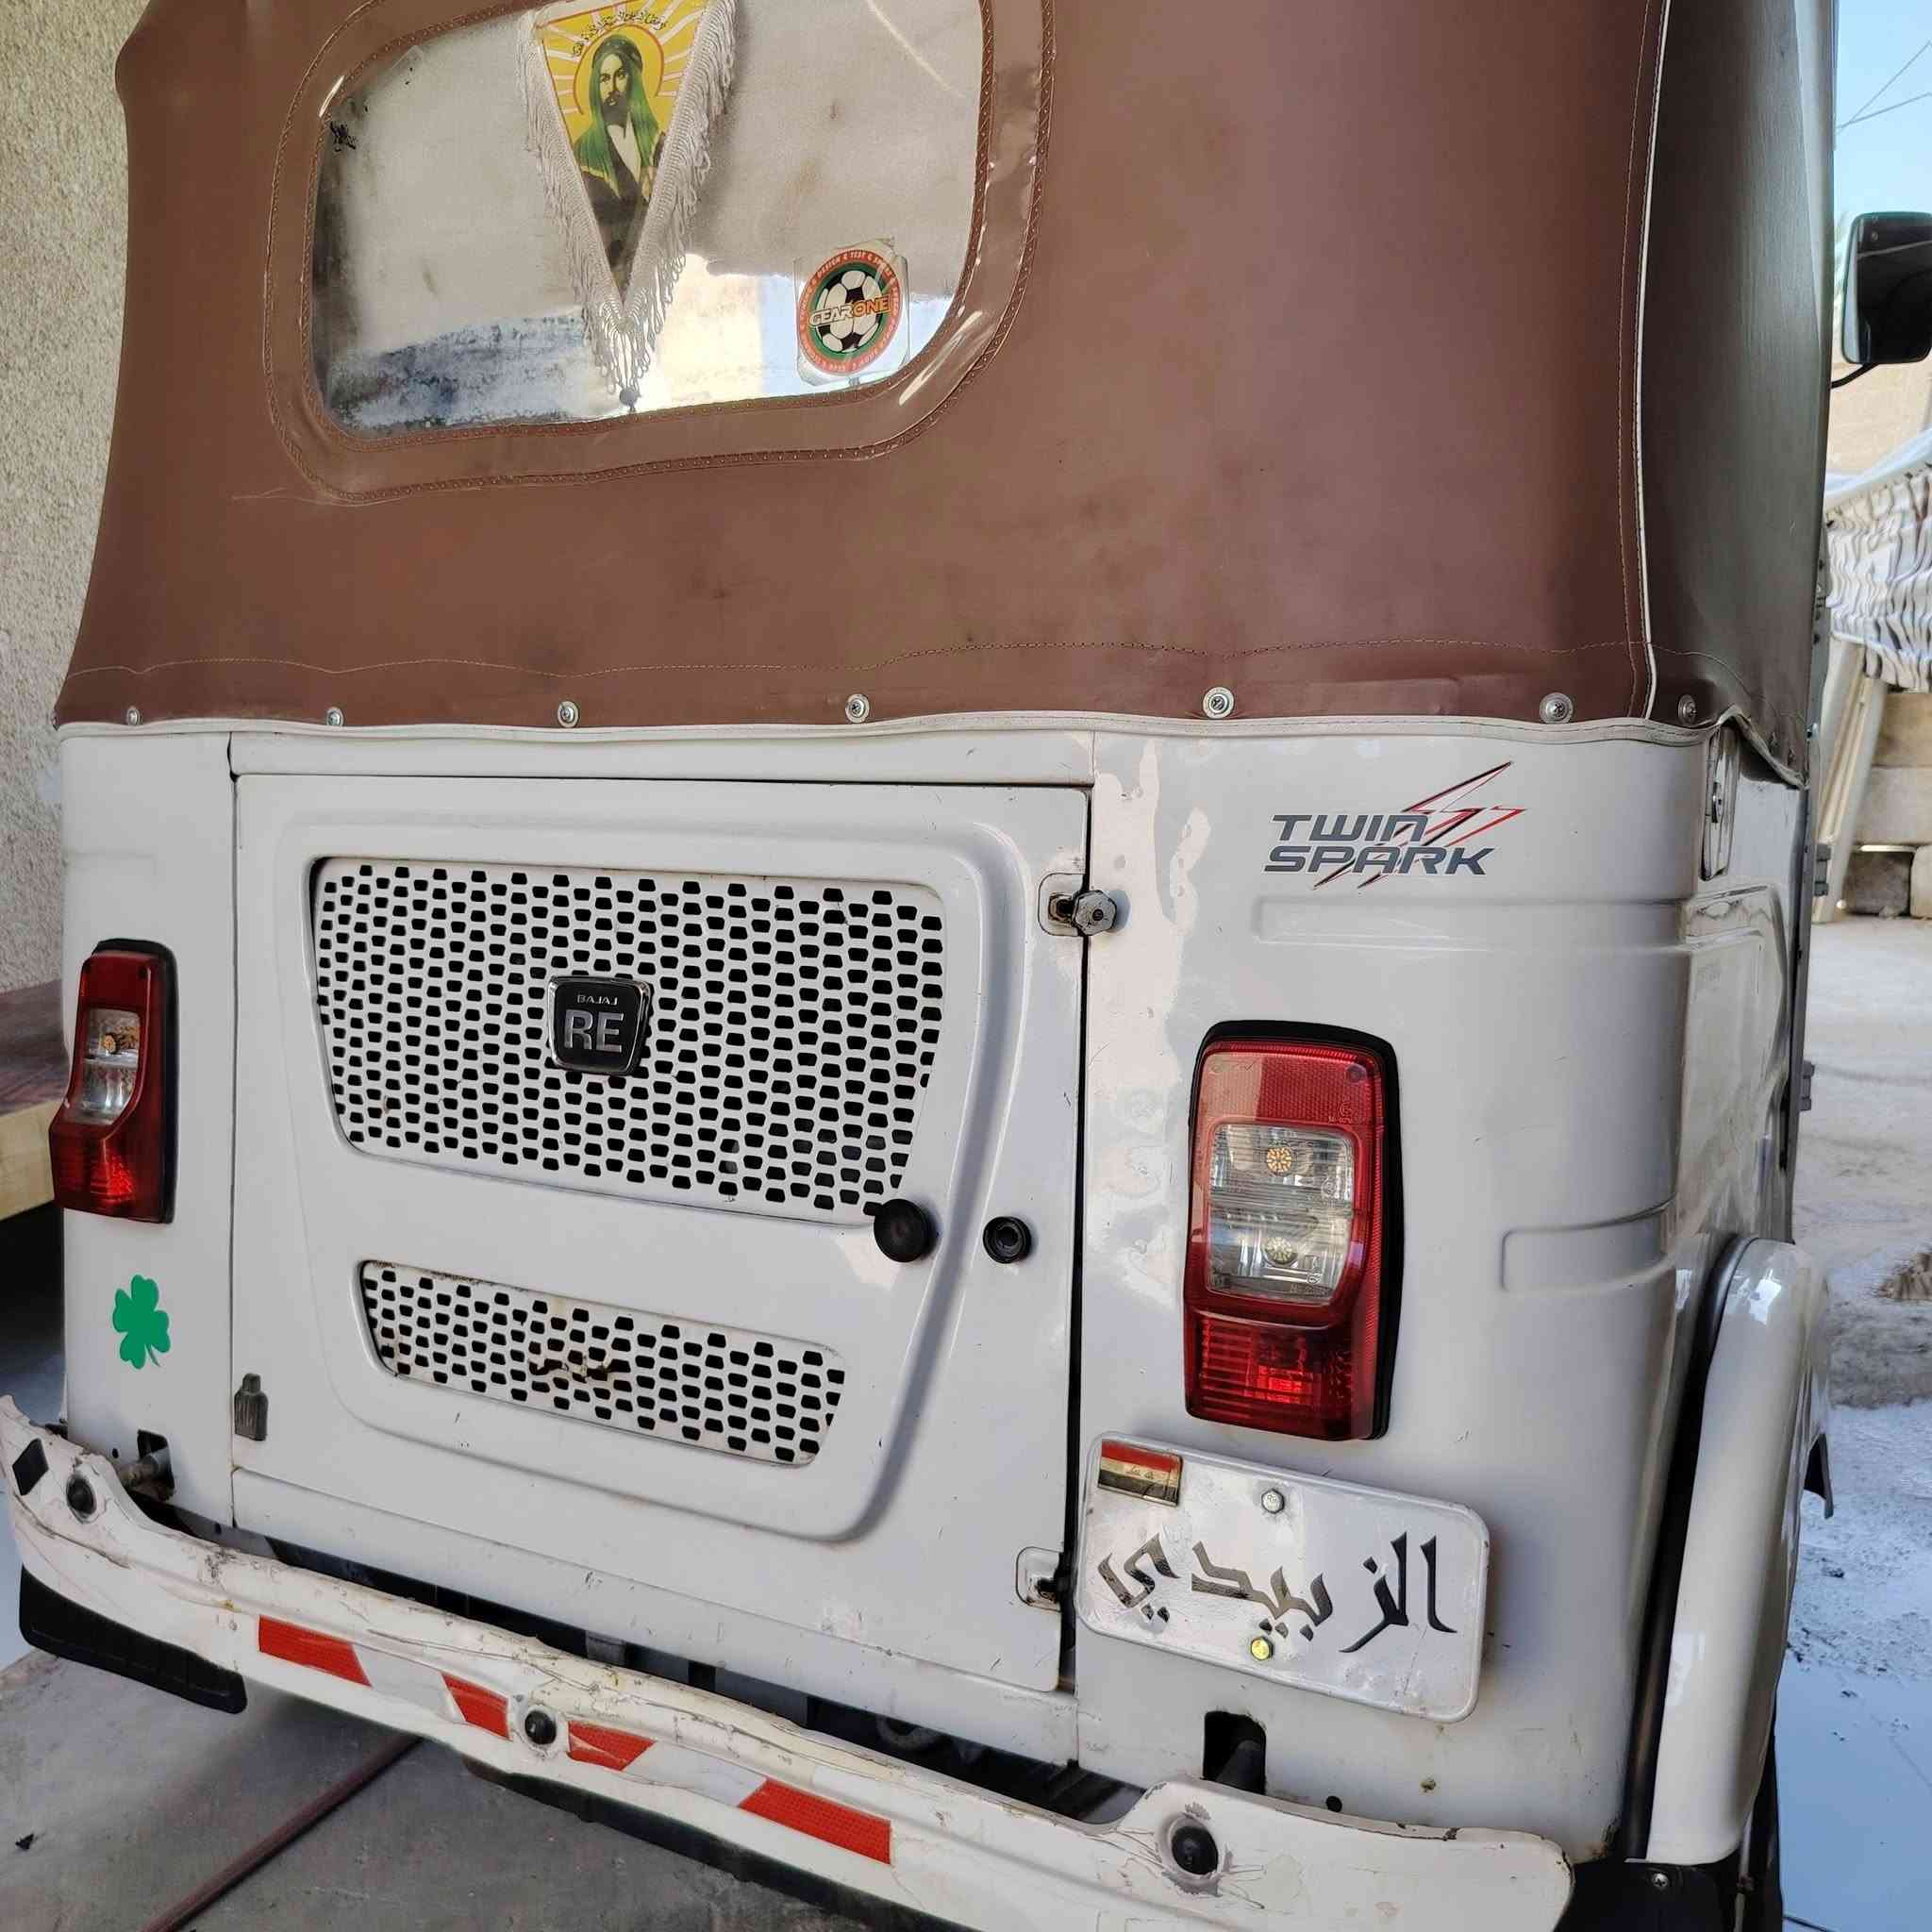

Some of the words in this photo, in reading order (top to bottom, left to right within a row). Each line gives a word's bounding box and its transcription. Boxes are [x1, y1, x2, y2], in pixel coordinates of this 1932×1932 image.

[1273, 814, 1428, 841] TWIN
[1264, 845, 1494, 874] SPARK
[577, 994, 618, 1006] BAJAJ
[564, 1009, 624, 1053] RE
